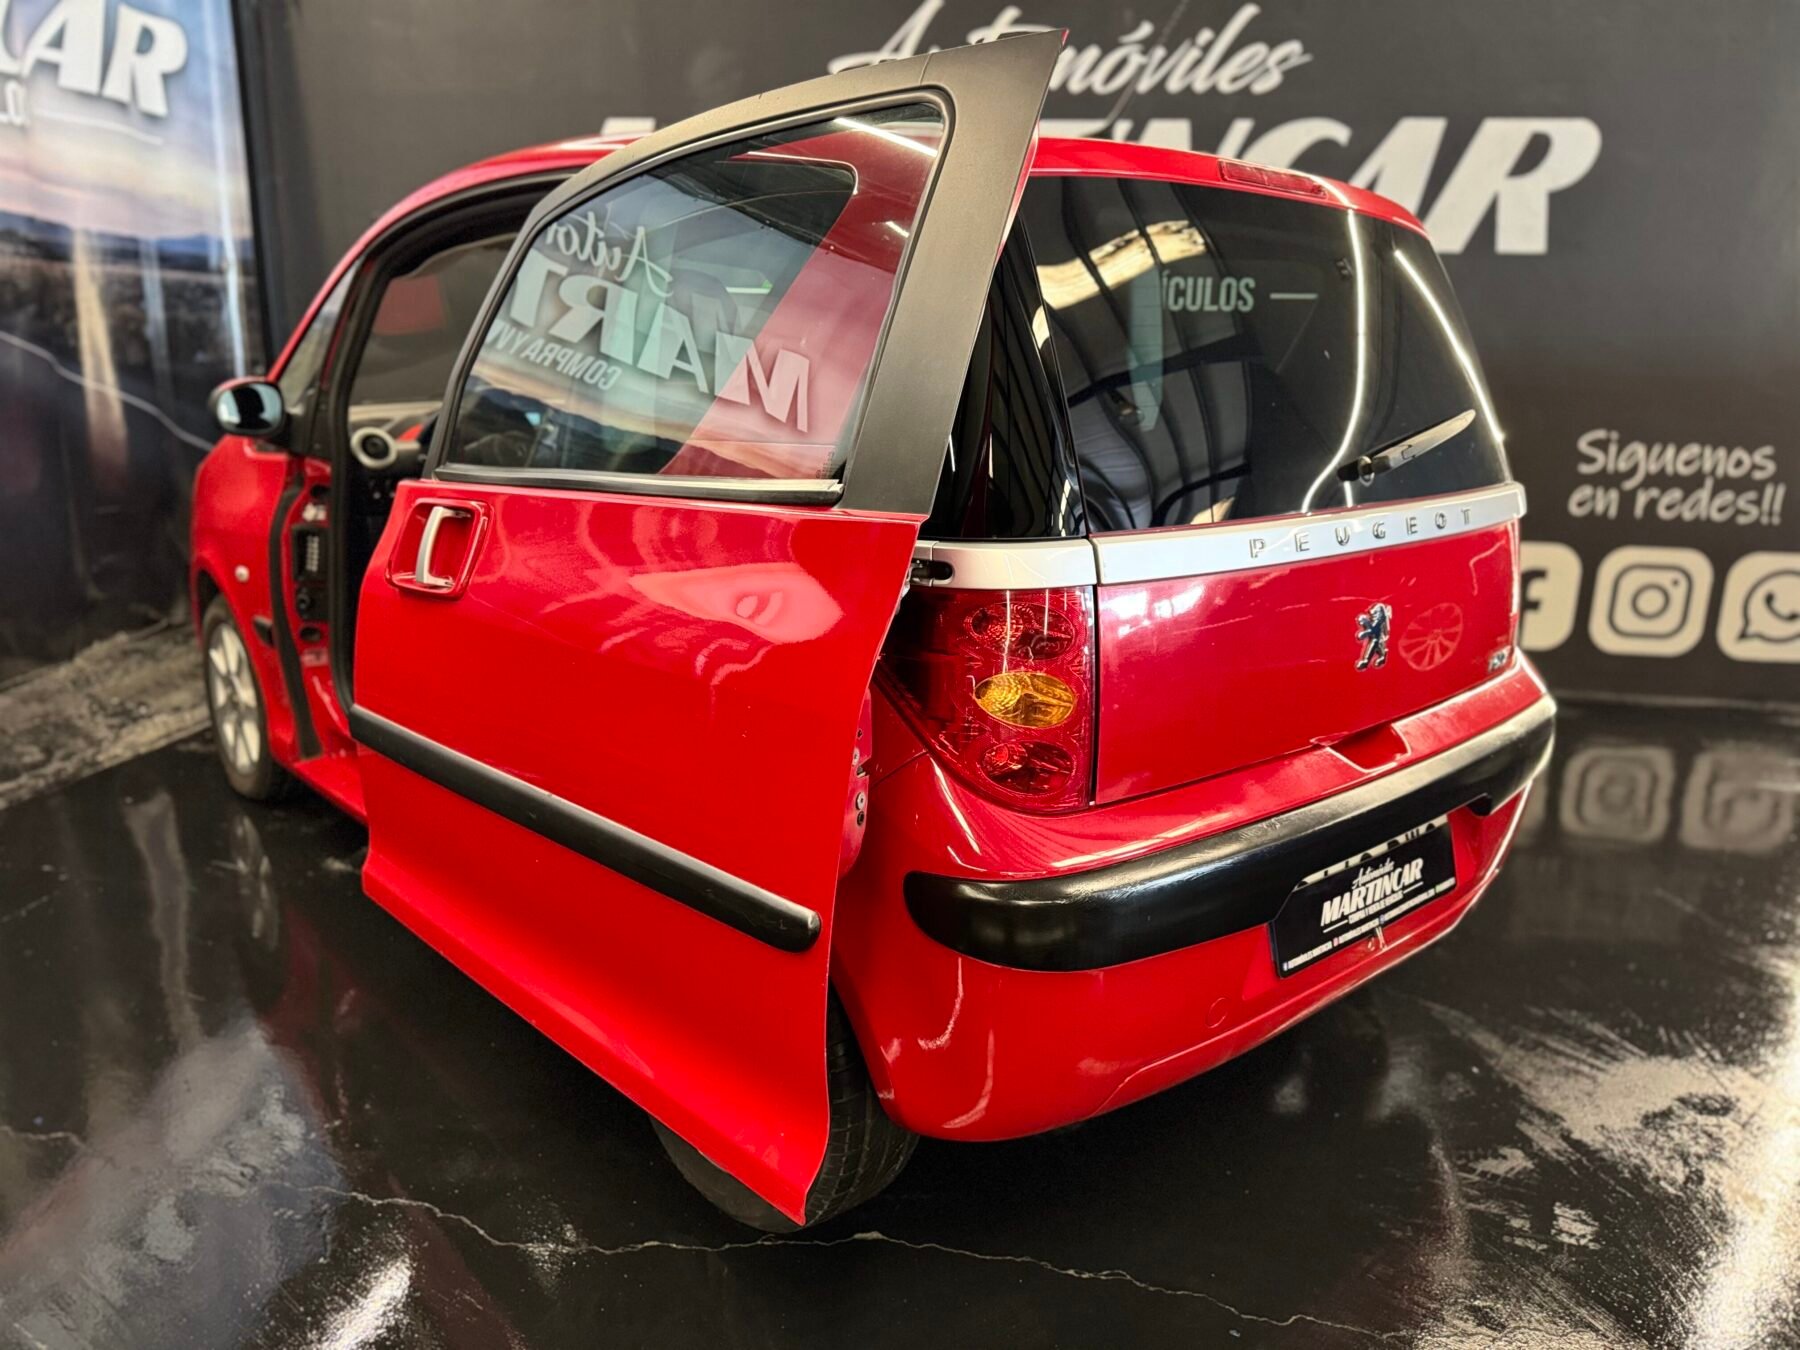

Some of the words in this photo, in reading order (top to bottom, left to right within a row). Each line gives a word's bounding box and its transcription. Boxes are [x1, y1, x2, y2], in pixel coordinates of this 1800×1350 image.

[1577, 428, 1777, 490] Siguenos
[1567, 484, 1620, 519] en
[1633, 475, 1786, 525] redes!!
[1249, 508, 1472, 558] PEUGEOT
[1320, 857, 1424, 926] MARTINCAR
